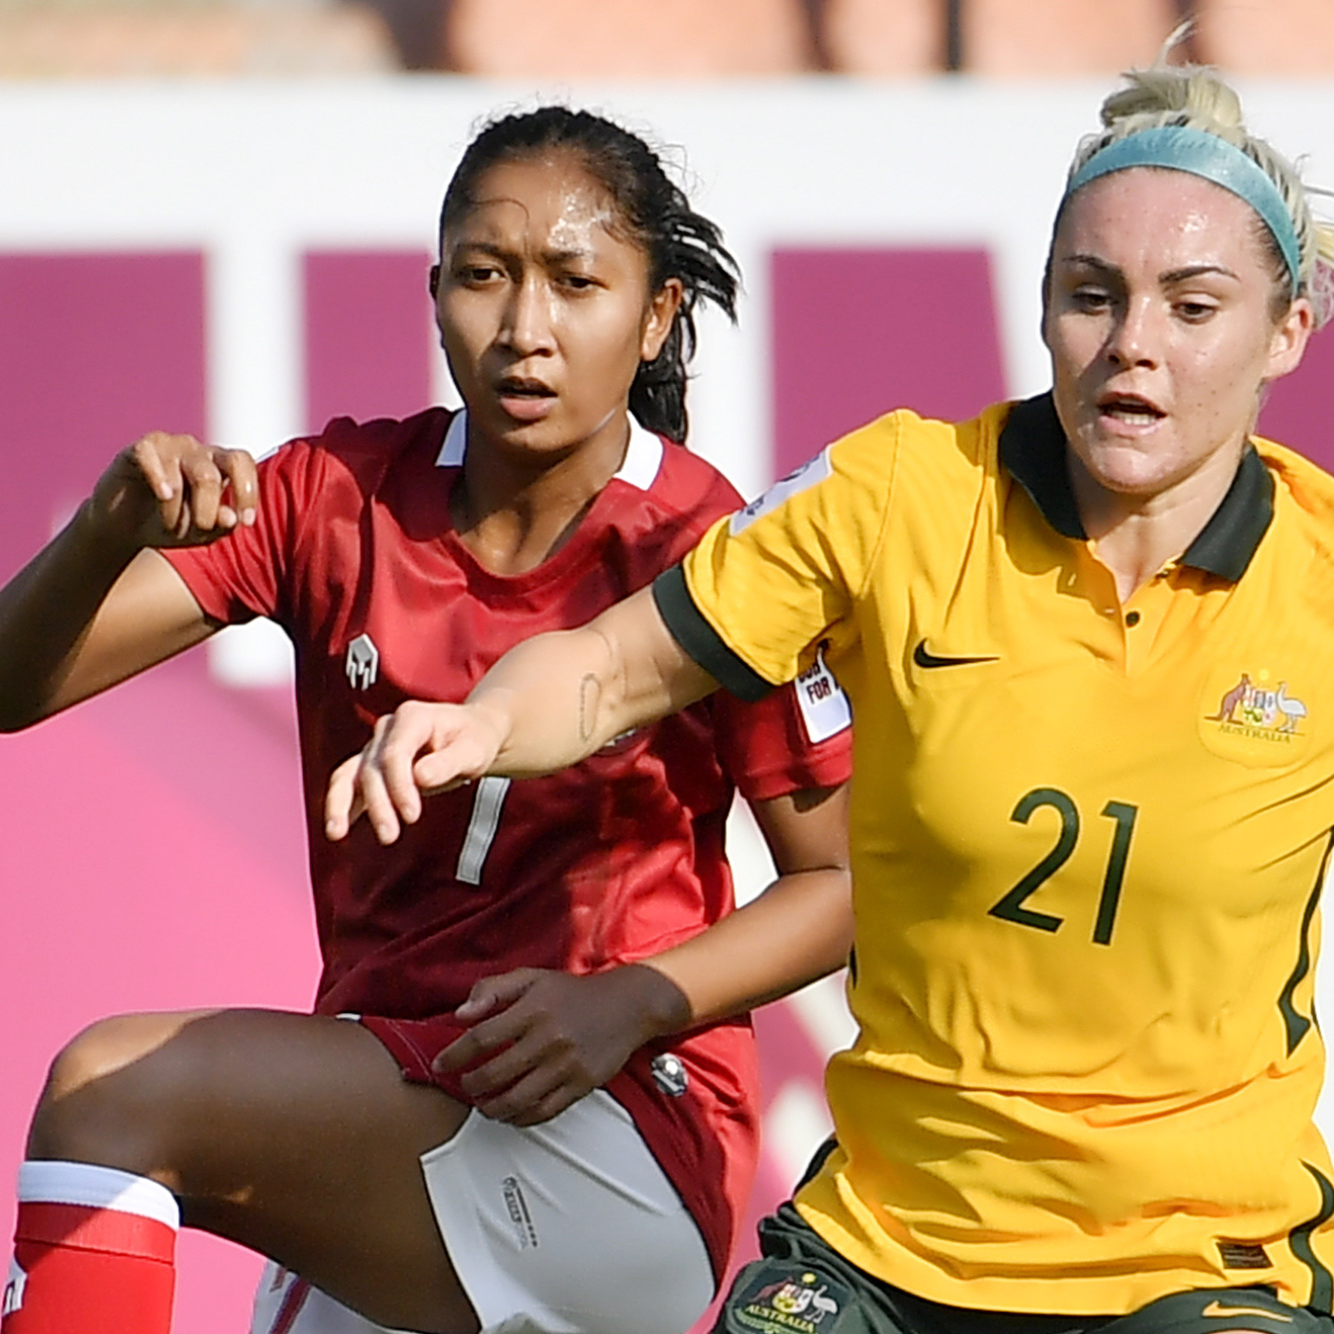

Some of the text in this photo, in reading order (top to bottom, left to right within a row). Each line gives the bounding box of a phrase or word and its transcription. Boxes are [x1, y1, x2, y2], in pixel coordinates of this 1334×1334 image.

[806, 676, 832, 704] FOR
[1218, 724, 1291, 743] AUSTRALIA
[986, 786, 1140, 947] 21
[746, 1304, 814, 1333] AUSTRALIA
